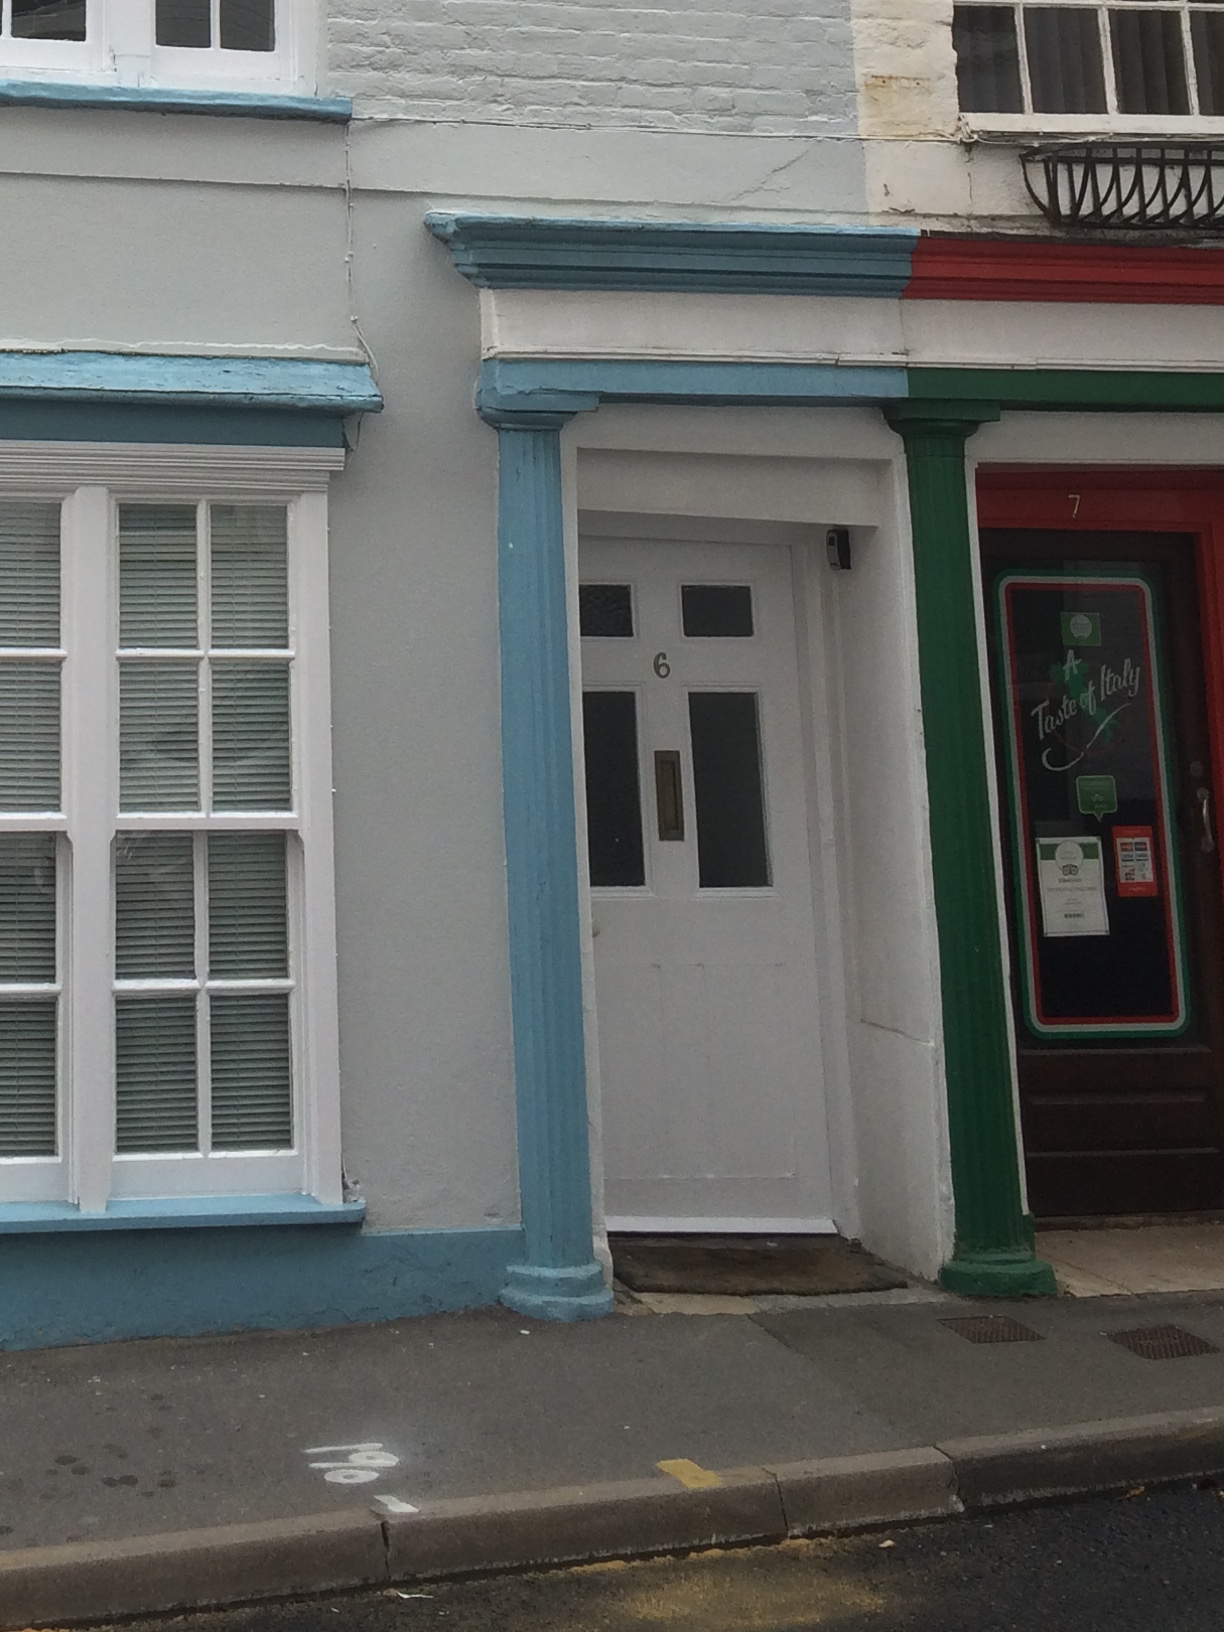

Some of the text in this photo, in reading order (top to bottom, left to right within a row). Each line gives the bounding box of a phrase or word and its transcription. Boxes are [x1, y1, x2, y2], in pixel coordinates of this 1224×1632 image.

[1067, 495, 1082, 518] 7
[653, 652, 671, 679] 6
[1063, 649, 1082, 681] A
[1031, 657, 1140, 741] Taste of Italy
